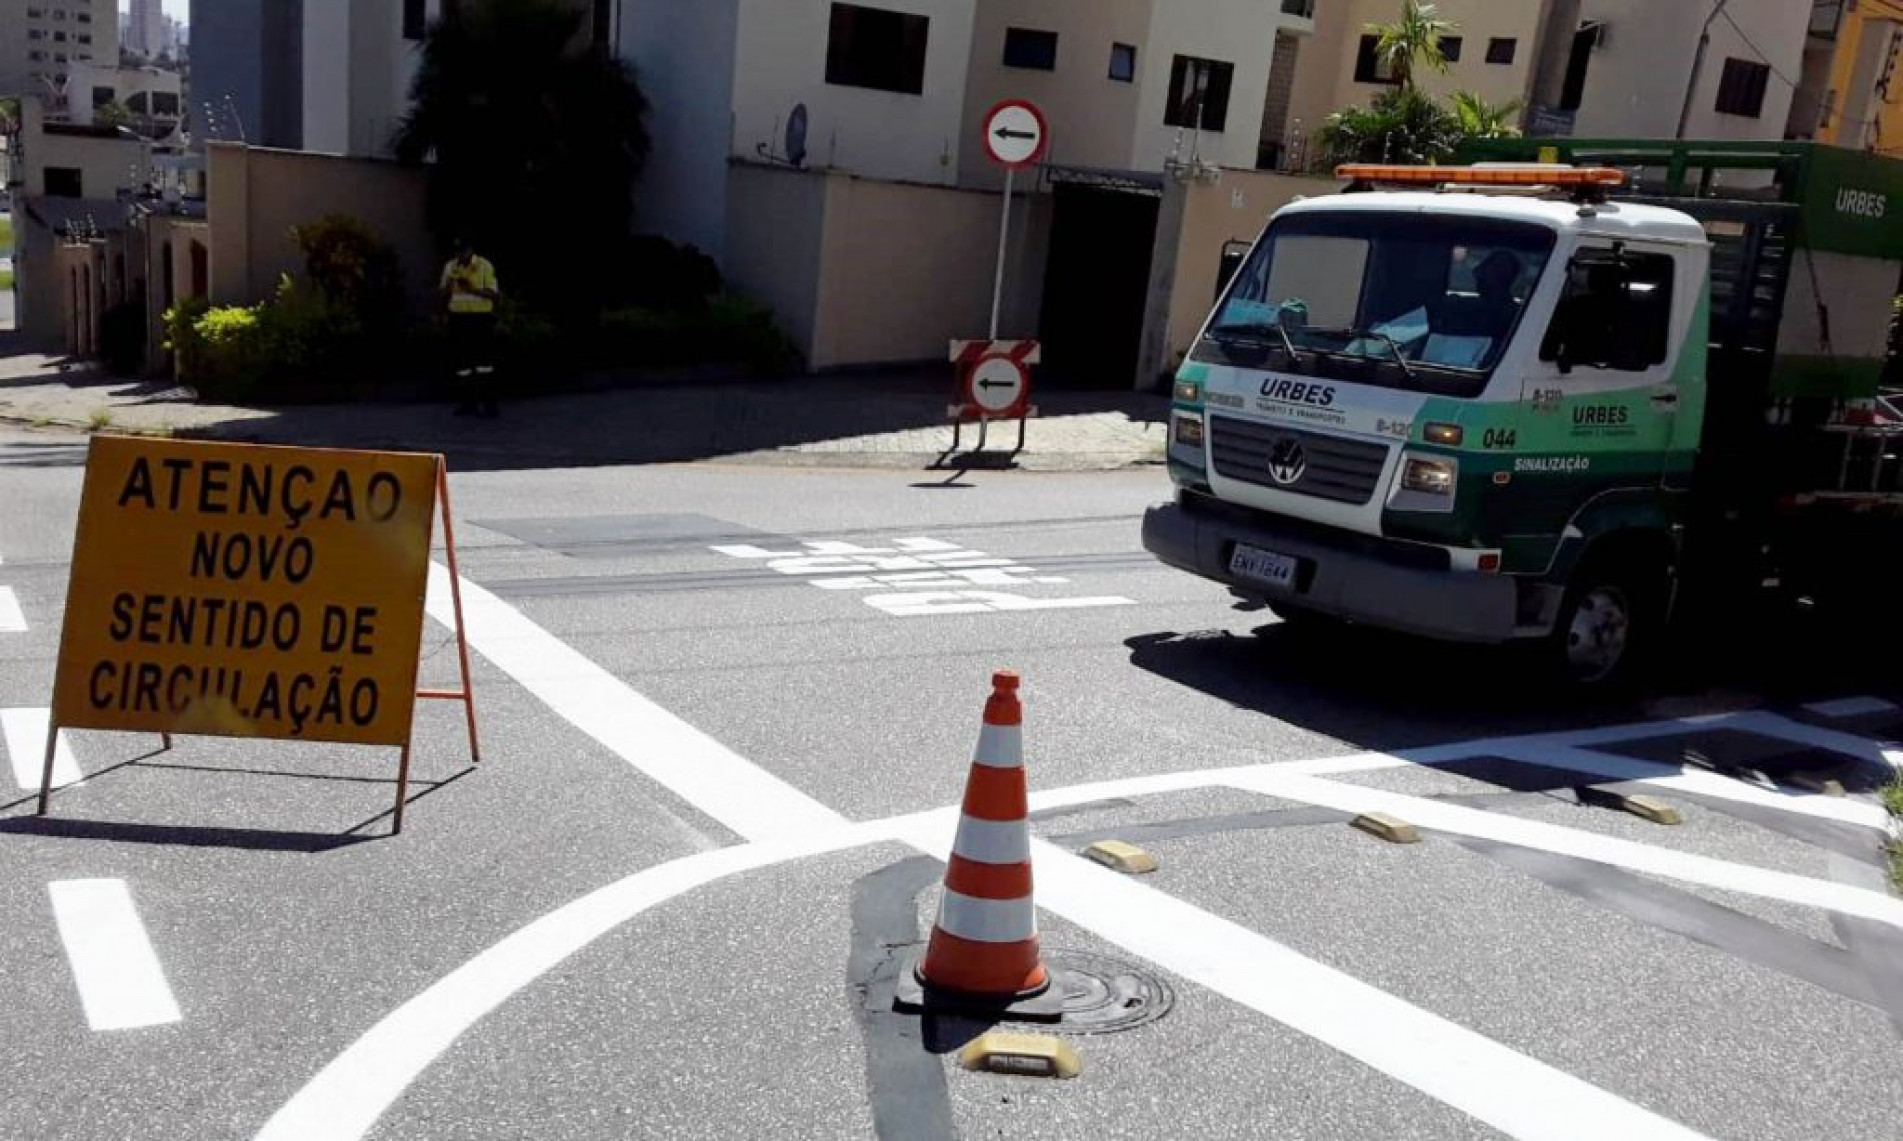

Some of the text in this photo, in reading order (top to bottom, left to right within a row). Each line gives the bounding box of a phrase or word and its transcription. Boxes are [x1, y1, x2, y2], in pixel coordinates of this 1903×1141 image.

[1835, 189, 1886, 218] URBES
[1259, 377, 1336, 406] URBES
[1572, 406, 1629, 424] URBES
[1482, 428, 1517, 448] 044
[189, 531, 315, 584] NOVO
[108, 592, 377, 655] SENTIDO DE
[88, 660, 380, 734] CIRCULAÇÃO
